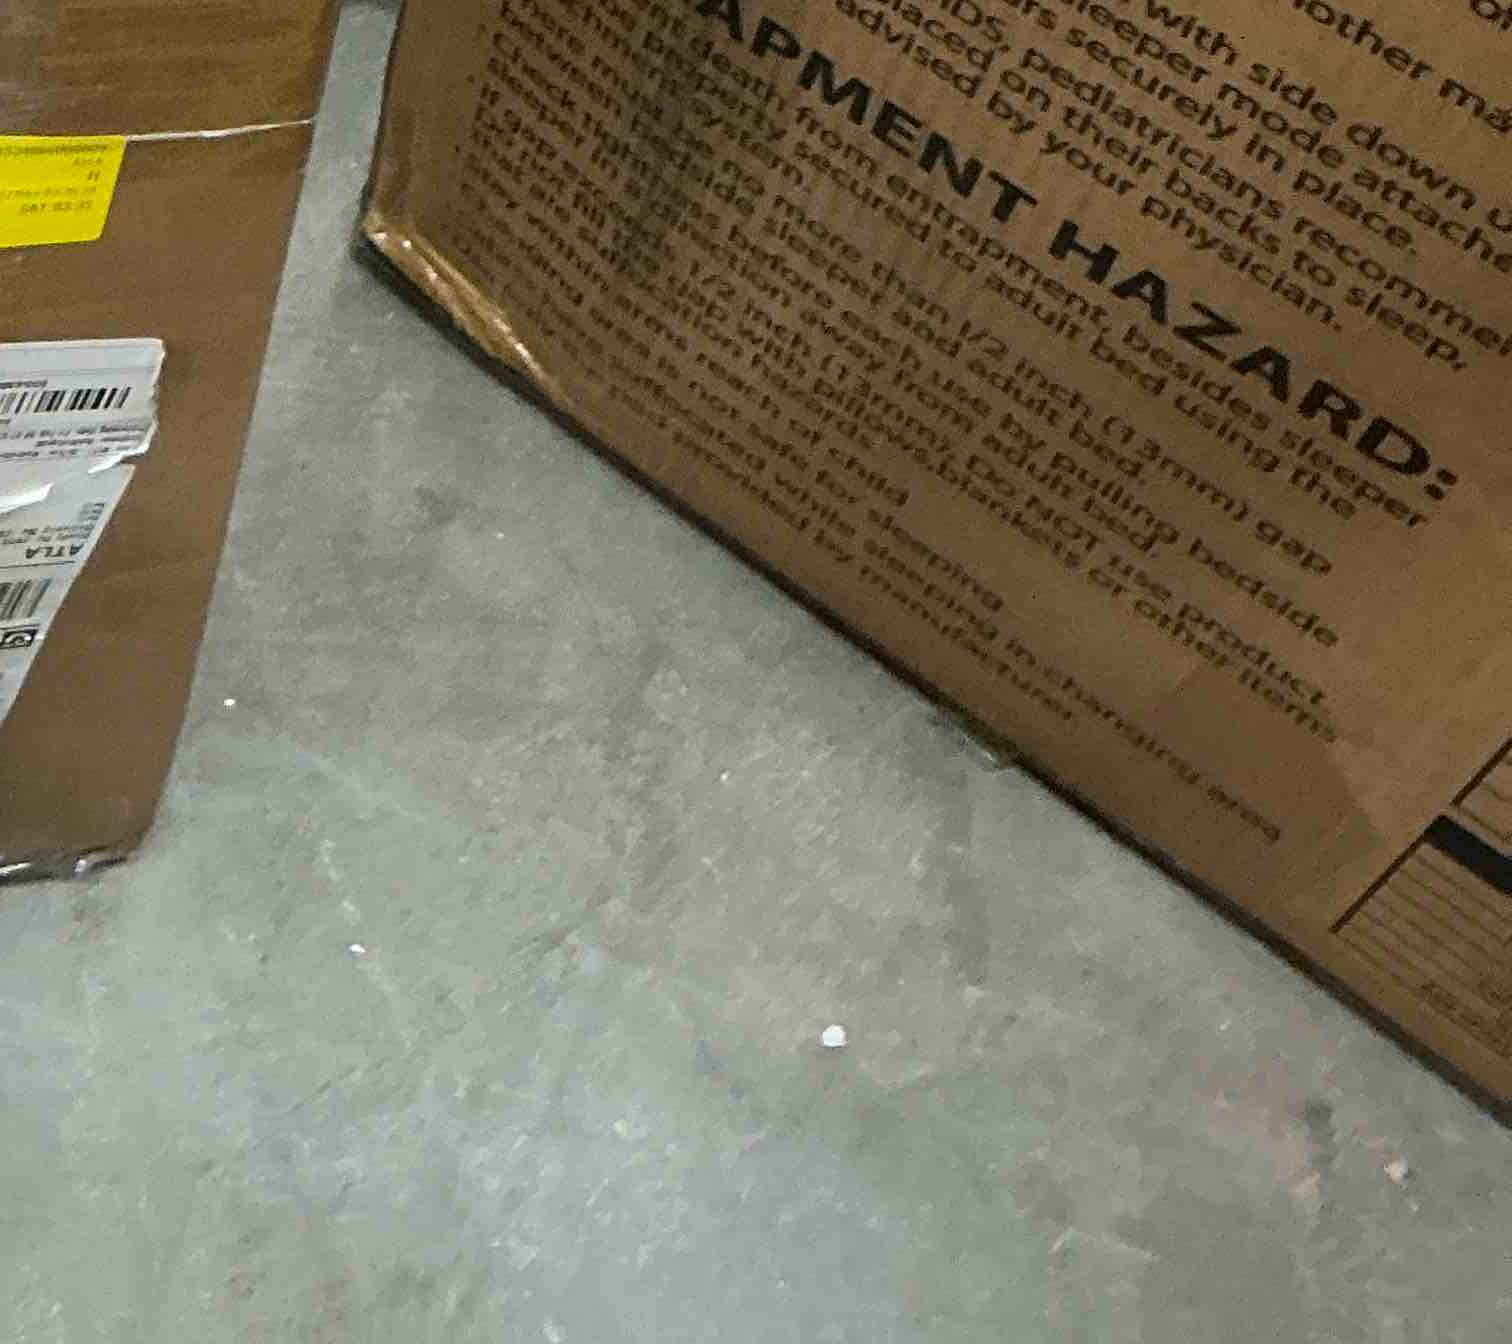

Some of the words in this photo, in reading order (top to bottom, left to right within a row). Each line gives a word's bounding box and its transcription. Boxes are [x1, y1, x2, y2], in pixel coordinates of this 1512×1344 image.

[986, 89, 1038, 135] by
[1038, 130, 1135, 196] your
[1139, 194, 1342, 332] physician.
[998, 69, 1052, 113] on
[1061, 105, 1155, 174] their
[1163, 166, 1281, 255] backs
[1291, 249, 1336, 288] to
[1344, 286, 1467, 372] sleep,
[1019, 46, 1281, 224] pediatricians
[1064, 26, 1239, 141] securely
[1243, 132, 1286, 173] in
[1291, 168, 1417, 256] place.
[1216, 82, 1345, 169] mode
[1247, 62, 1337, 126] side
[1345, 123, 1477, 211] down
[1046, 218, 1458, 501] HAZARD:
[1121, 324, 1270, 431] besides
[1283, 429, 1428, 528] sleeper
[1173, 394, 1281, 473] using
[1289, 466, 1356, 519] the
[1254, 519, 1332, 575] gap
